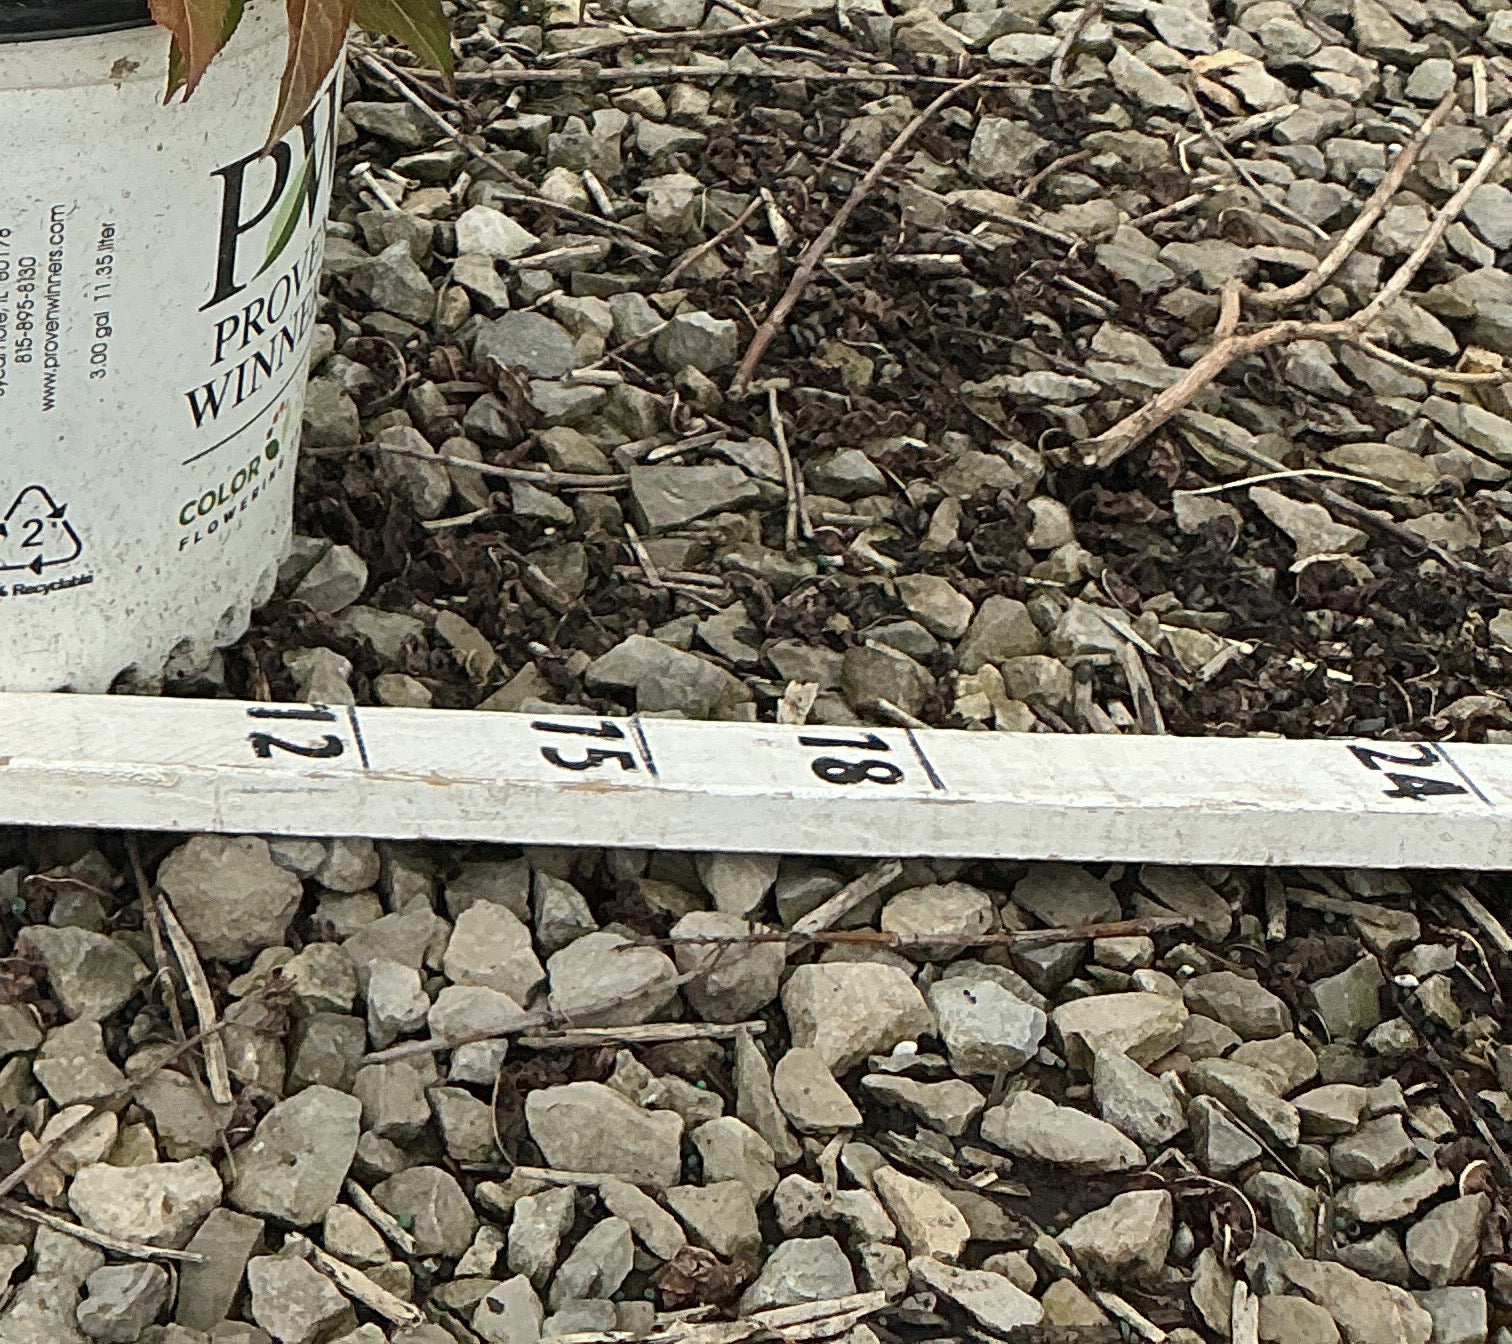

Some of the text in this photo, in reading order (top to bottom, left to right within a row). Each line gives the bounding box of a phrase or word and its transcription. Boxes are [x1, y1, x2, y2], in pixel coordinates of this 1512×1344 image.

[14, 256, 37, 363] 815-895-8130
[42, 204, 66, 411] www.provenwinners.com
[94, 311, 113, 338] gal
[90, 342, 108, 379] 3.00
[179, 455, 261, 525] COLOR
[20, 518, 43, 548] 2
[12, 574, 94, 596] Recyclable
[246, 703, 344, 759] 12
[530, 719, 639, 772] 15
[798, 732, 904, 785] 18
[1345, 743, 1469, 802] 24
